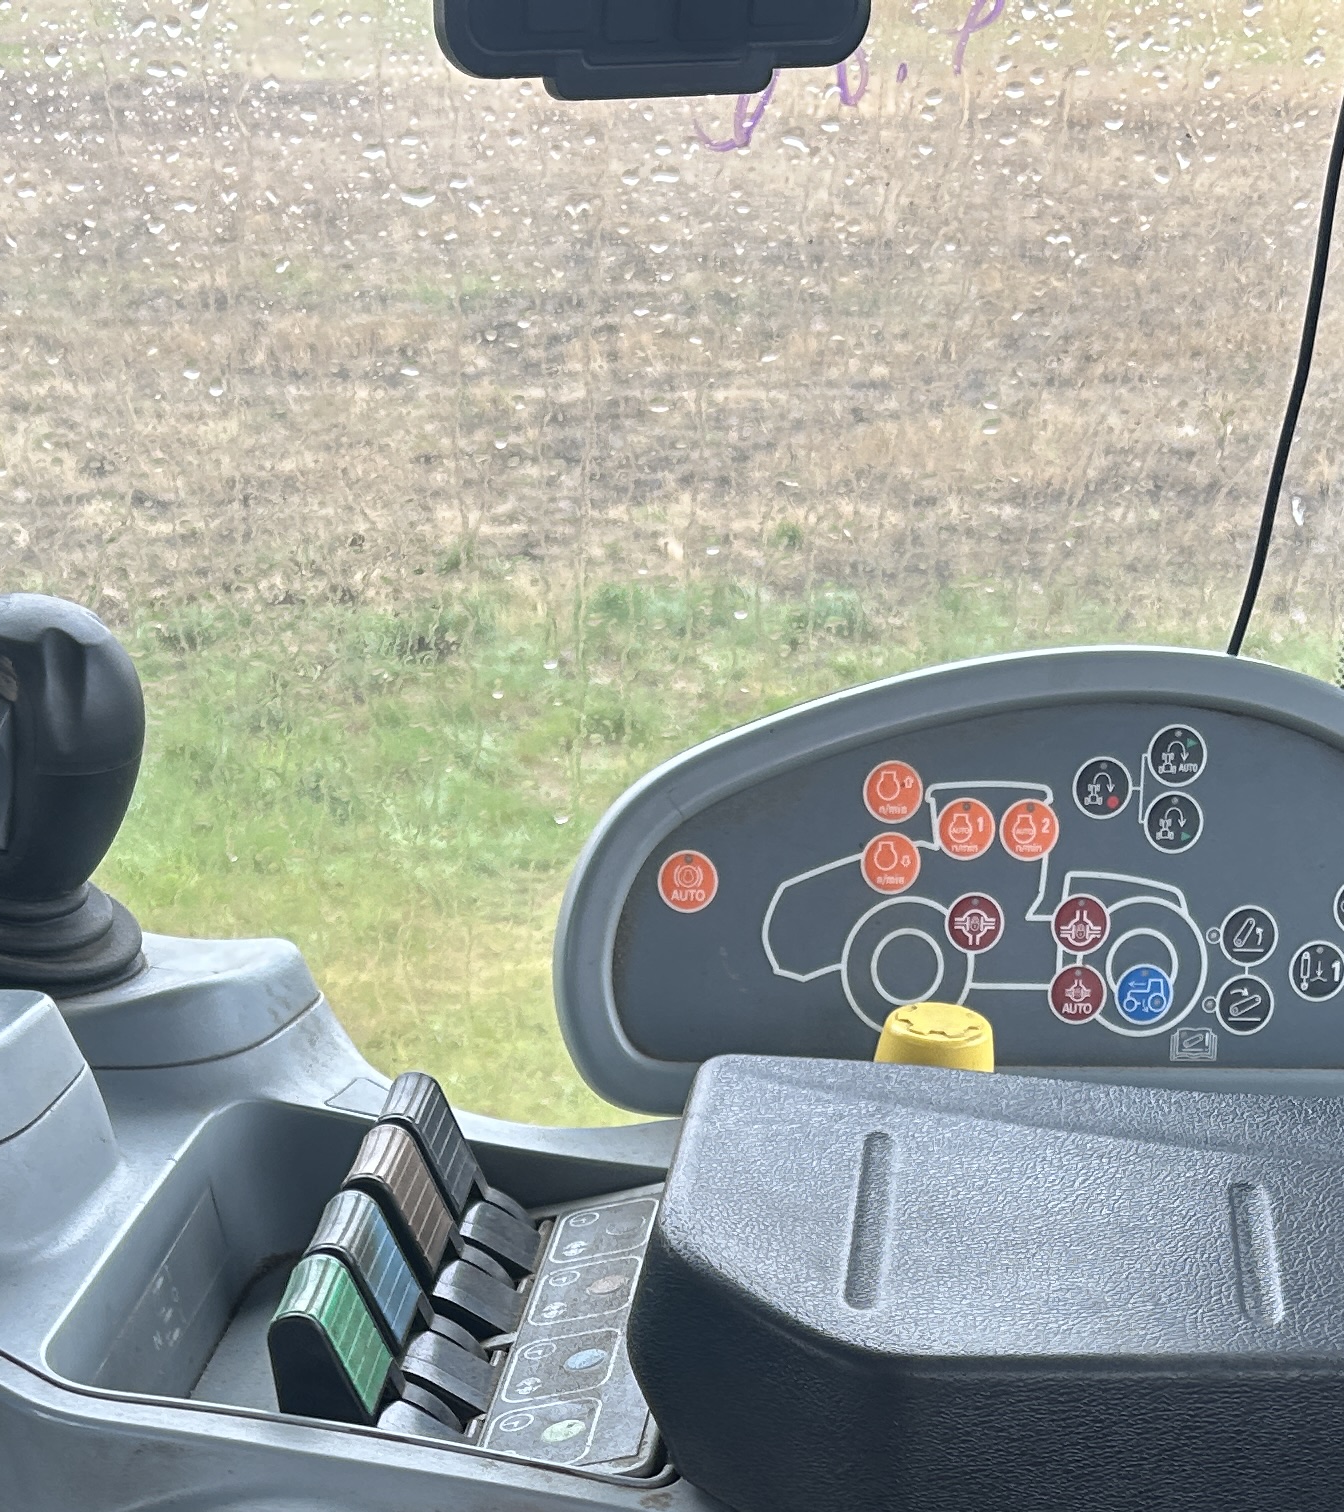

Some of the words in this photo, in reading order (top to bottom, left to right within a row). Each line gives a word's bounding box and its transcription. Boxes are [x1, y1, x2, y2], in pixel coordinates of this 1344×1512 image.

[1178, 762, 1198, 774] AUTO
[977, 816, 984, 832] 1
[1041, 818, 1050, 834] 2
[671, 889, 706, 902] AUTO
[1331, 959, 1341, 982] 1
[1061, 1002, 1093, 1015] AUTO
